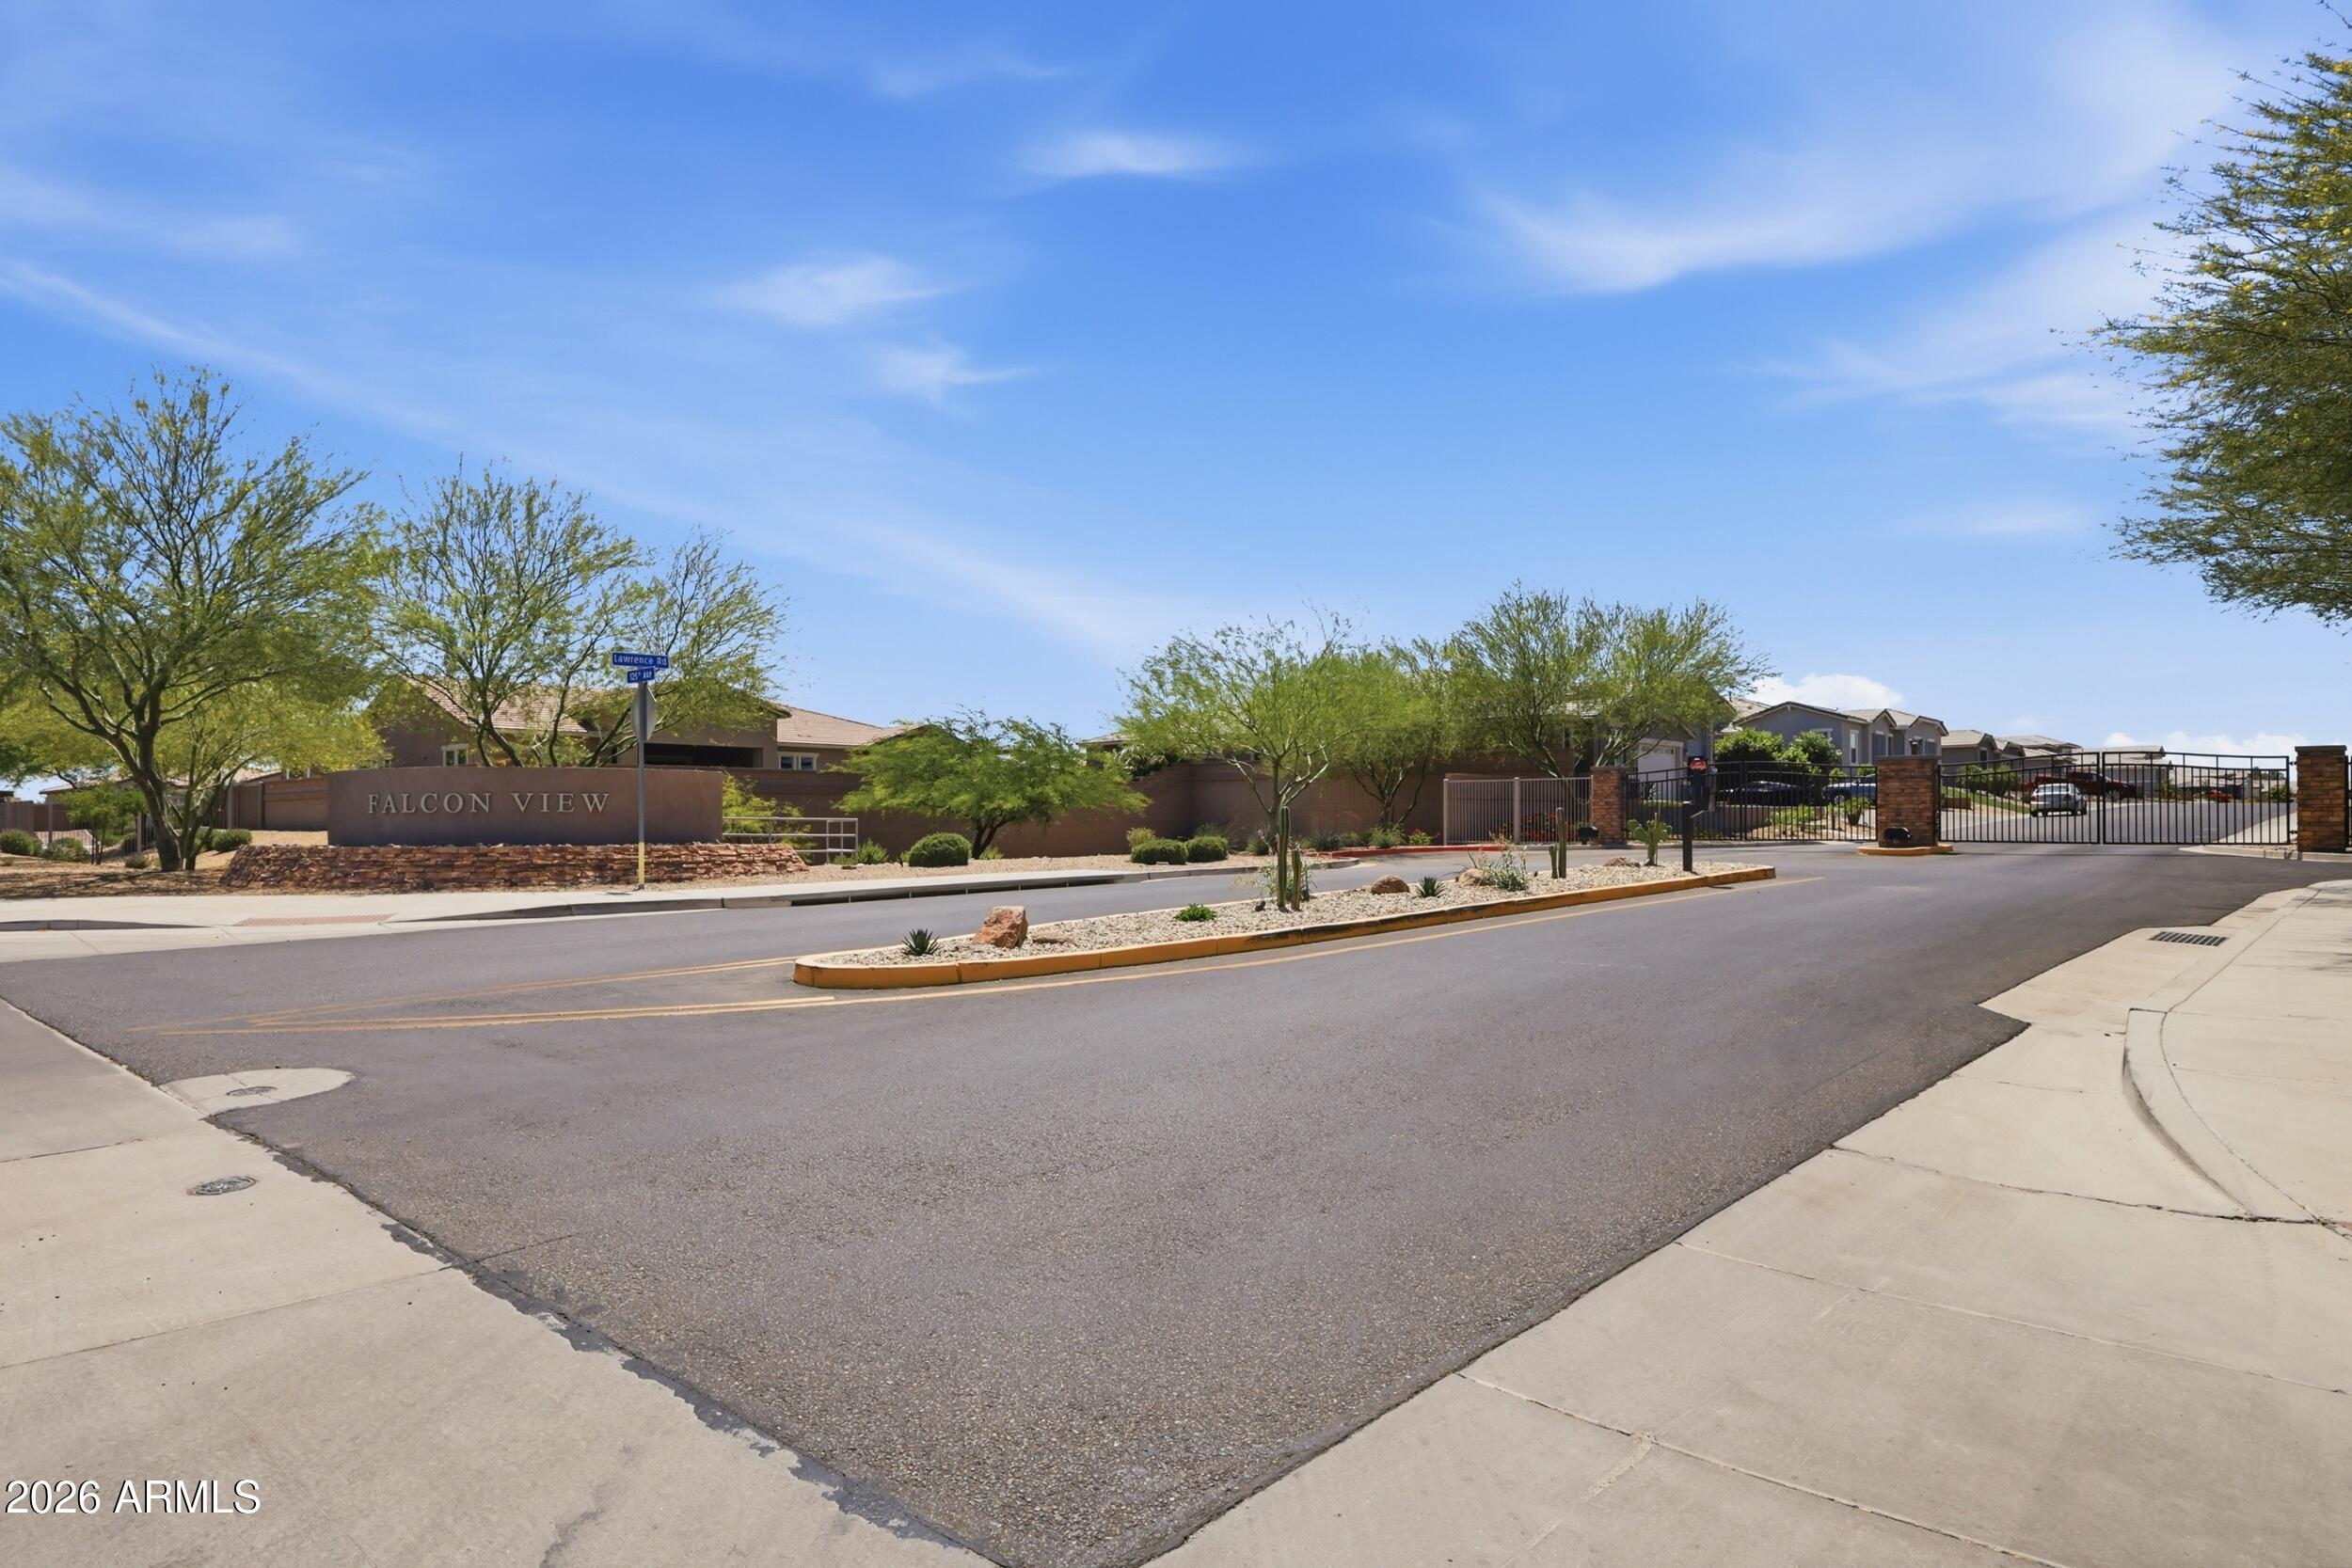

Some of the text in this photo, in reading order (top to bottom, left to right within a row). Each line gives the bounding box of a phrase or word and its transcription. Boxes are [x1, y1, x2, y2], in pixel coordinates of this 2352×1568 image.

[613, 654, 667, 666] Lawrence Rd
[367, 792, 610, 815] FALCON VIEW
